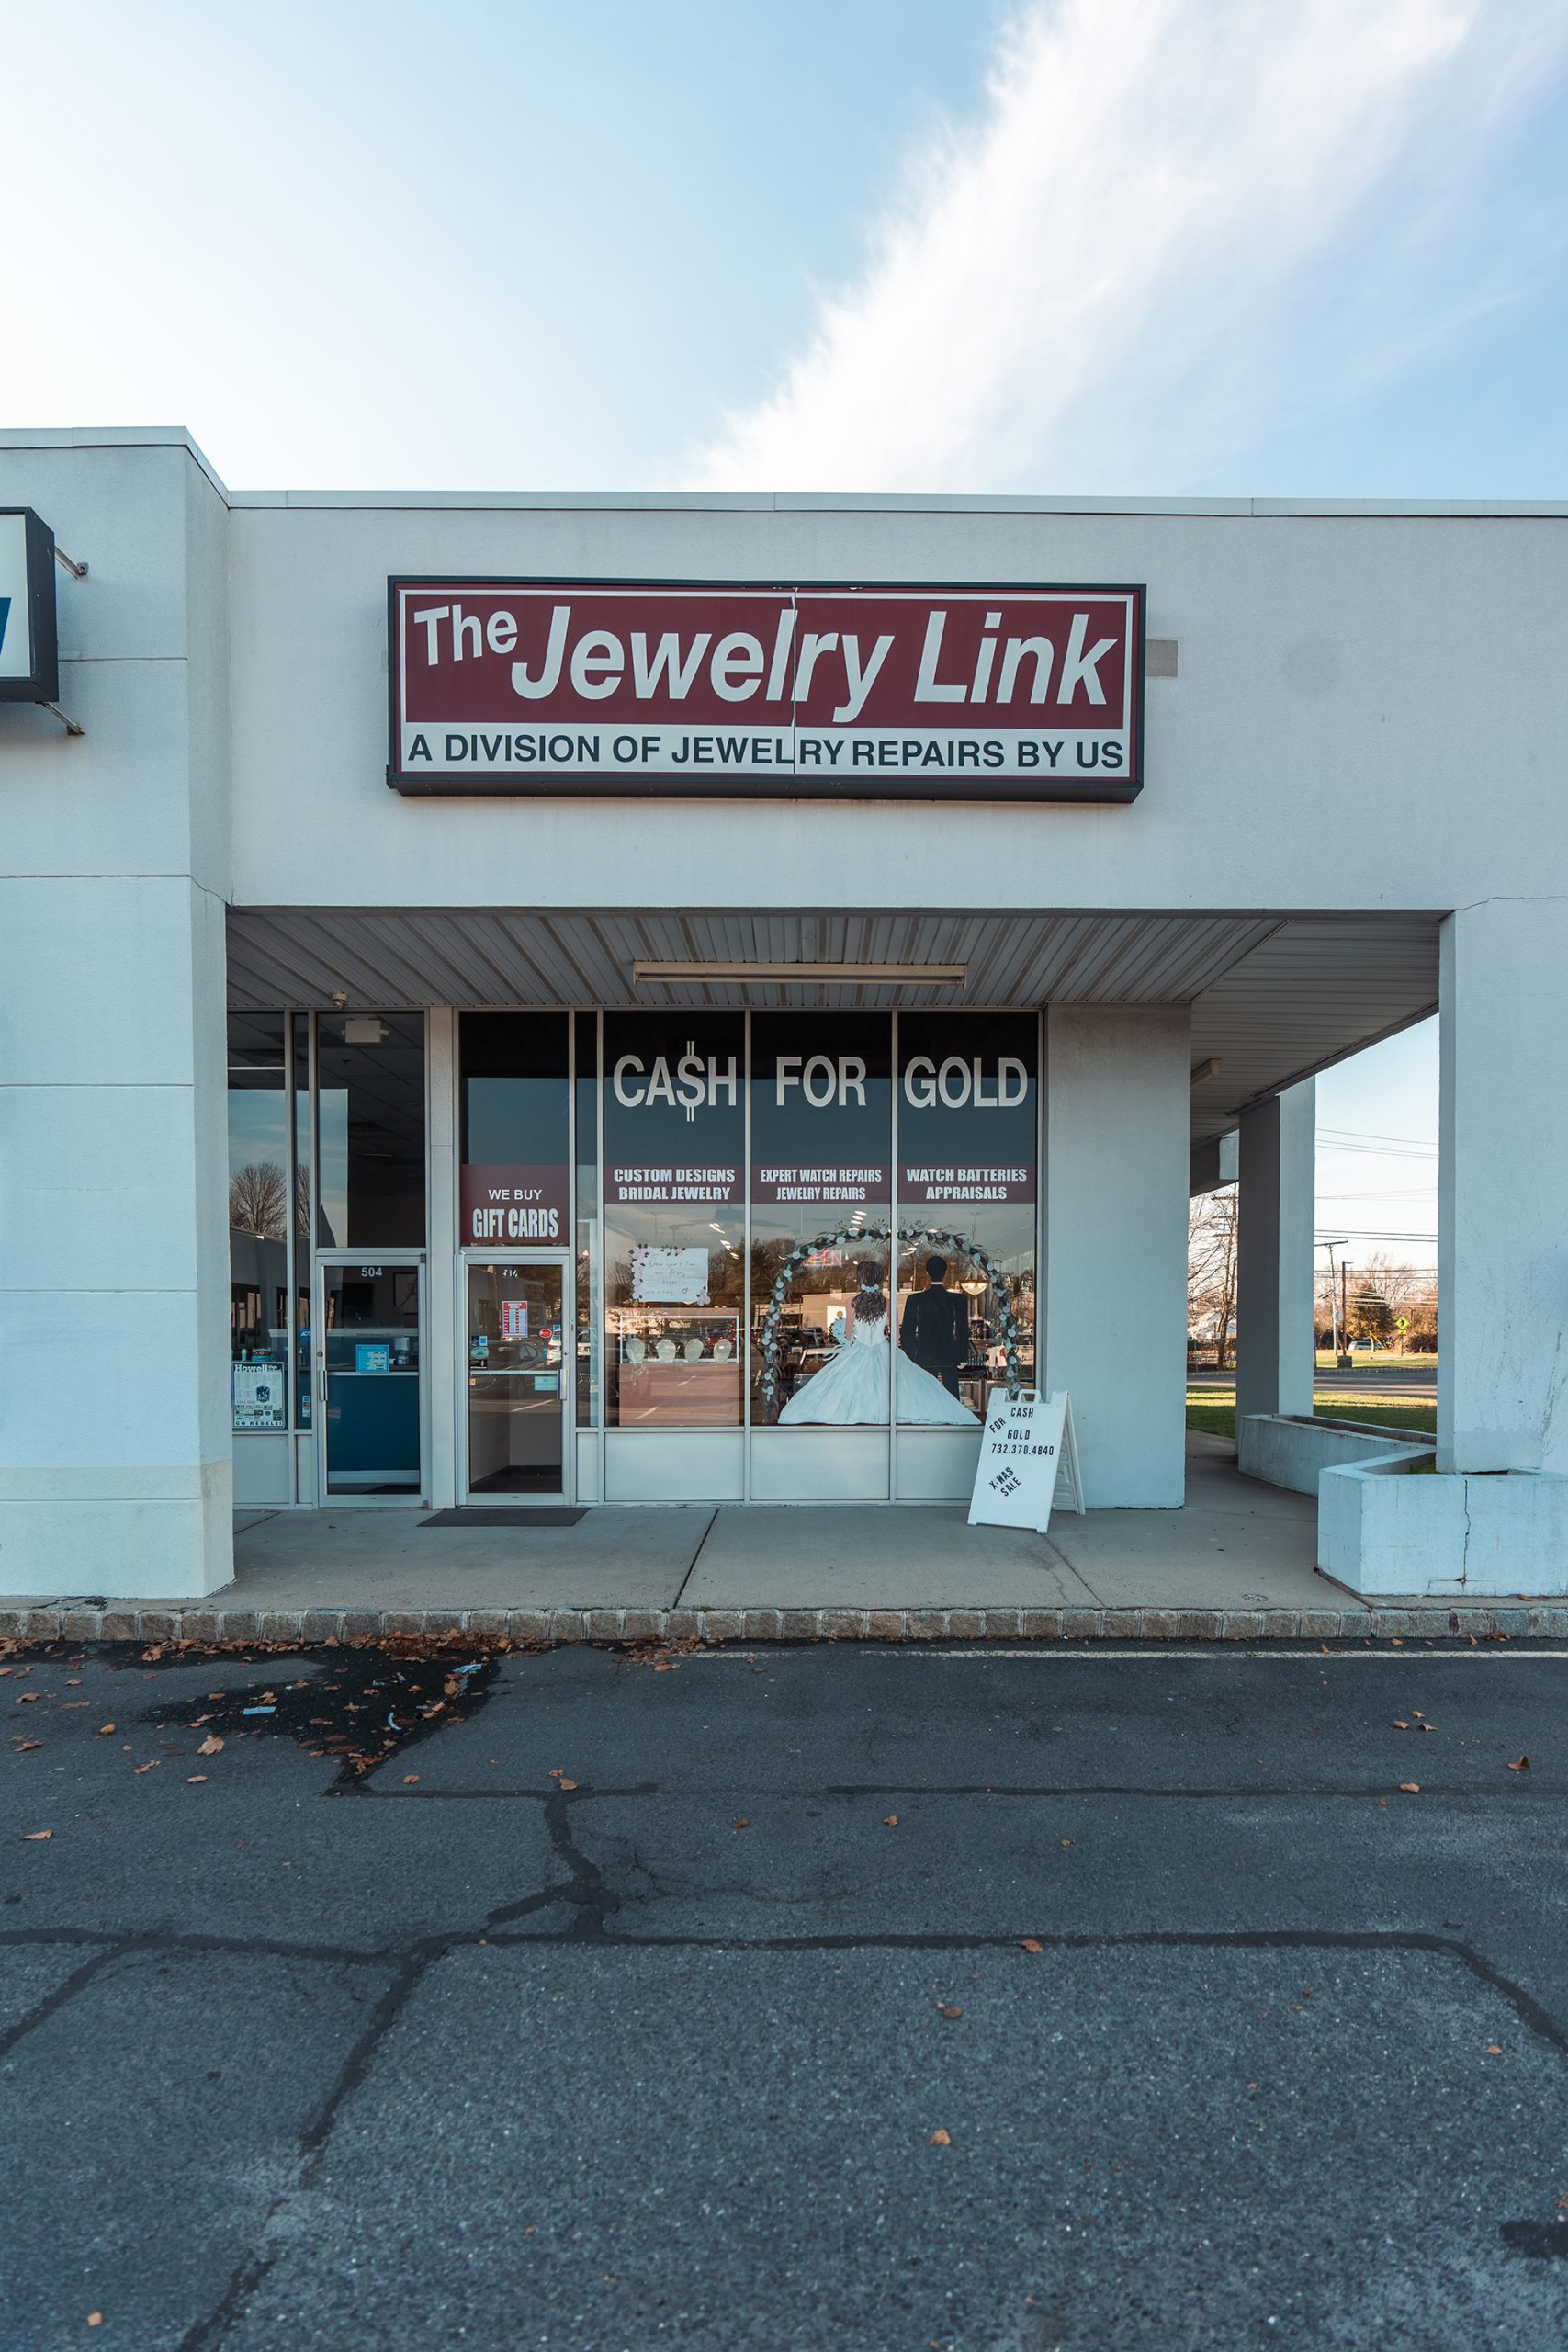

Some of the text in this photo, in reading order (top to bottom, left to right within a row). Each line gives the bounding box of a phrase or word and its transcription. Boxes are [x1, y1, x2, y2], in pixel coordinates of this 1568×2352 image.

[414, 605, 1119, 724] The Jewelry Link
[408, 735, 1123, 769] A DIVISION OF JEWELRY REPAIRS BY US
[776, 1056, 866, 1107] FOR
[904, 1056, 1028, 1109] GOLD
[614, 1169, 736, 1182] CUSTOM DESIGNS
[761, 1169, 882, 1182] EXPERT WATCH REPAIRS
[906, 1169, 1027, 1182] WATCH BATTERIES
[489, 1190, 542, 1200] WE BUY
[619, 1187, 731, 1200] BRIDAL JEWELRY
[776, 1187, 866, 1200] JEWELRY REPAIRS
[926, 1187, 1008, 1200] APPRAISALS
[472, 1208, 558, 1238] GIFT CARDS
[361, 1267, 382, 1277] 504
[234, 1364, 267, 1373] Howell
[1010, 1408, 1034, 1418] CASH
[989, 1417, 1006, 1433] FOR
[1007, 1430, 1030, 1440] GOLD
[991, 1443, 1055, 1455] 732.370.4840
[989, 1467, 1014, 1490] X-MAS
[1000, 1476, 1021, 1497] SALE
